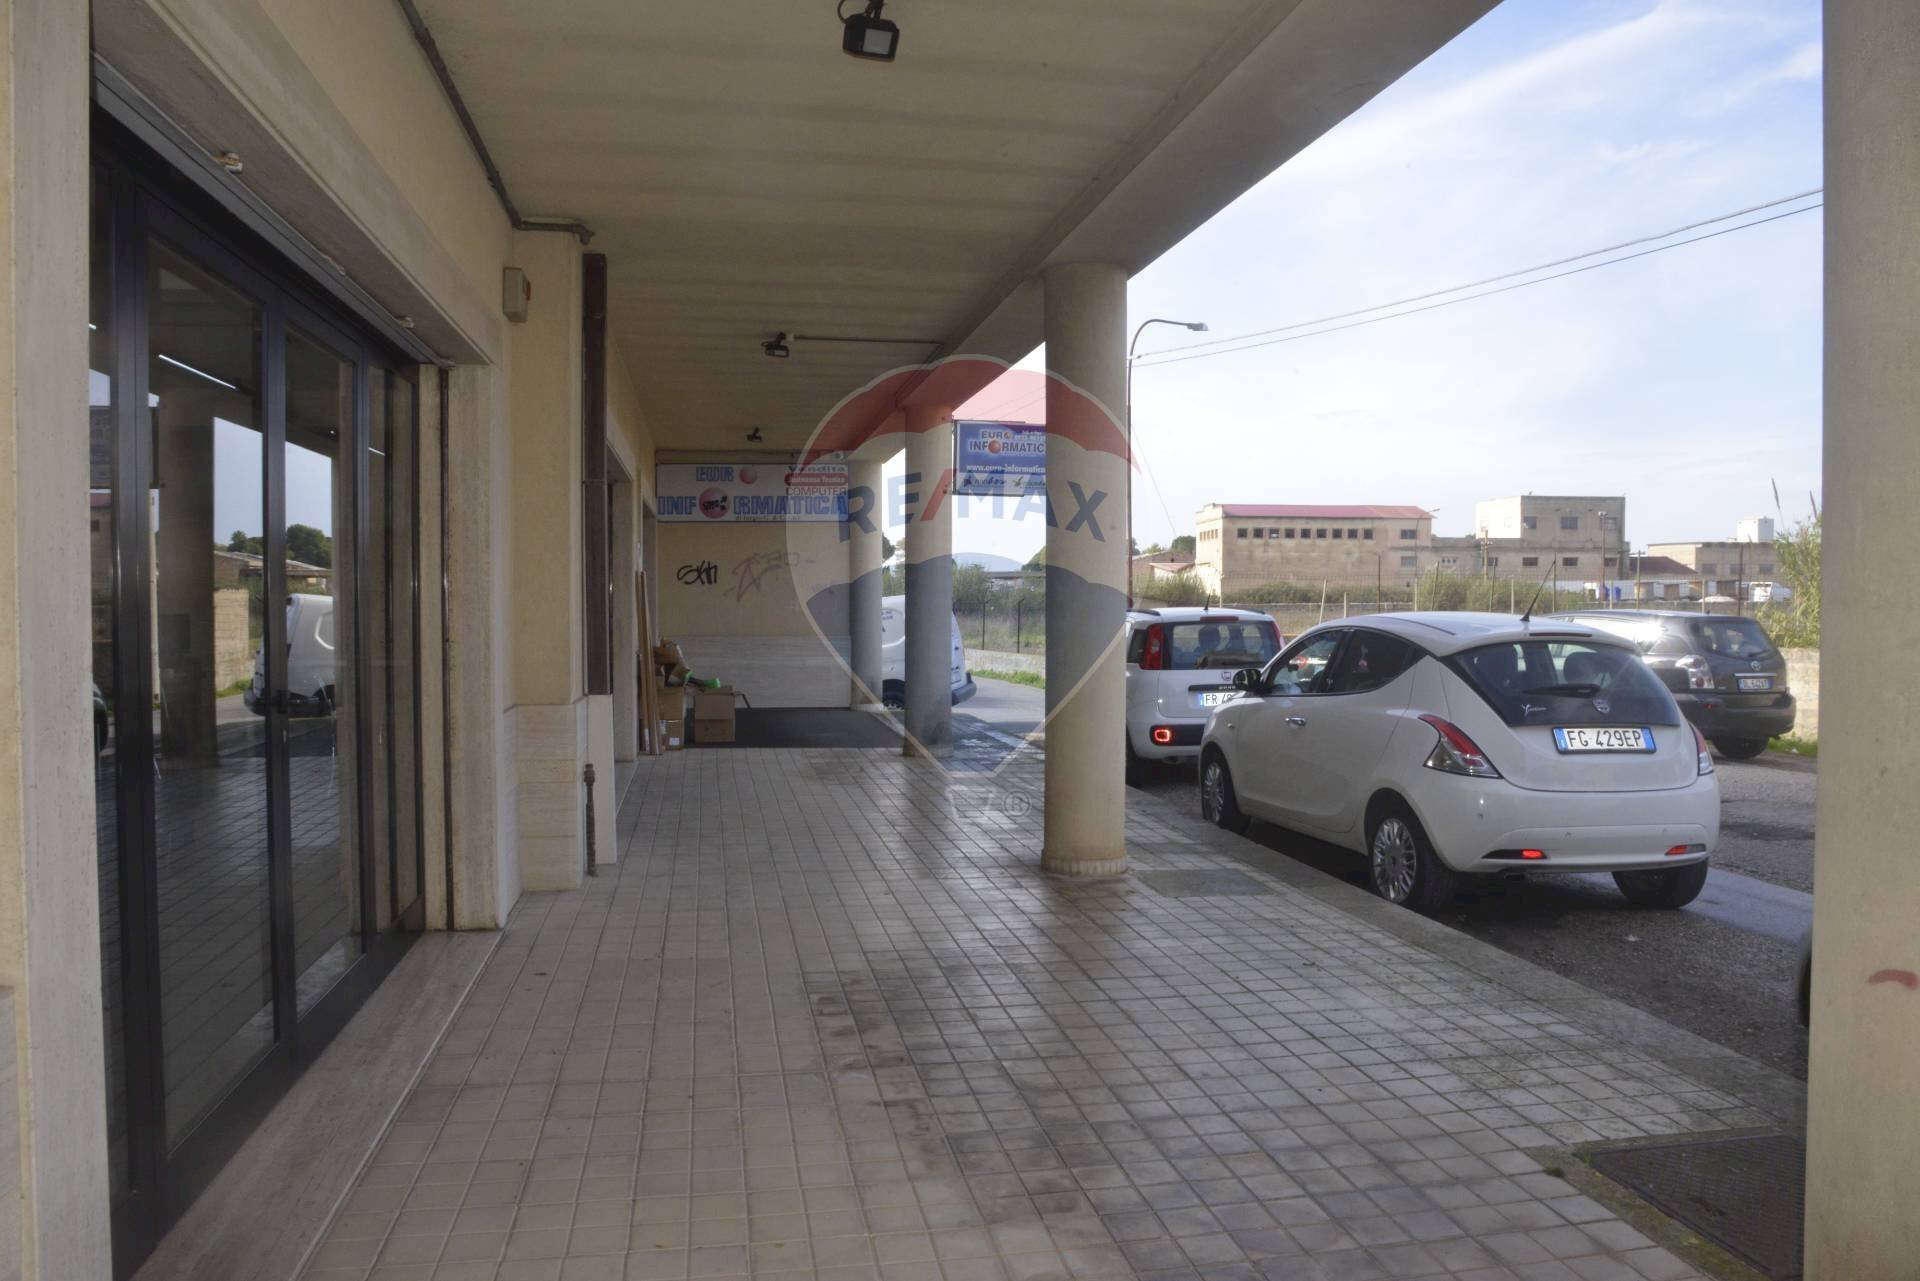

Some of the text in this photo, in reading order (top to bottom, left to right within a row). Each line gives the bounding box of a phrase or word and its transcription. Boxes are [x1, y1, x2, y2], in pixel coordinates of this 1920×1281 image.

[968, 440, 1046, 454] INFORMATIC
[786, 487, 847, 496] COMPUTER
[1205, 694, 1218, 705] FR
[1566, 730, 1641, 748] FG 429EP
